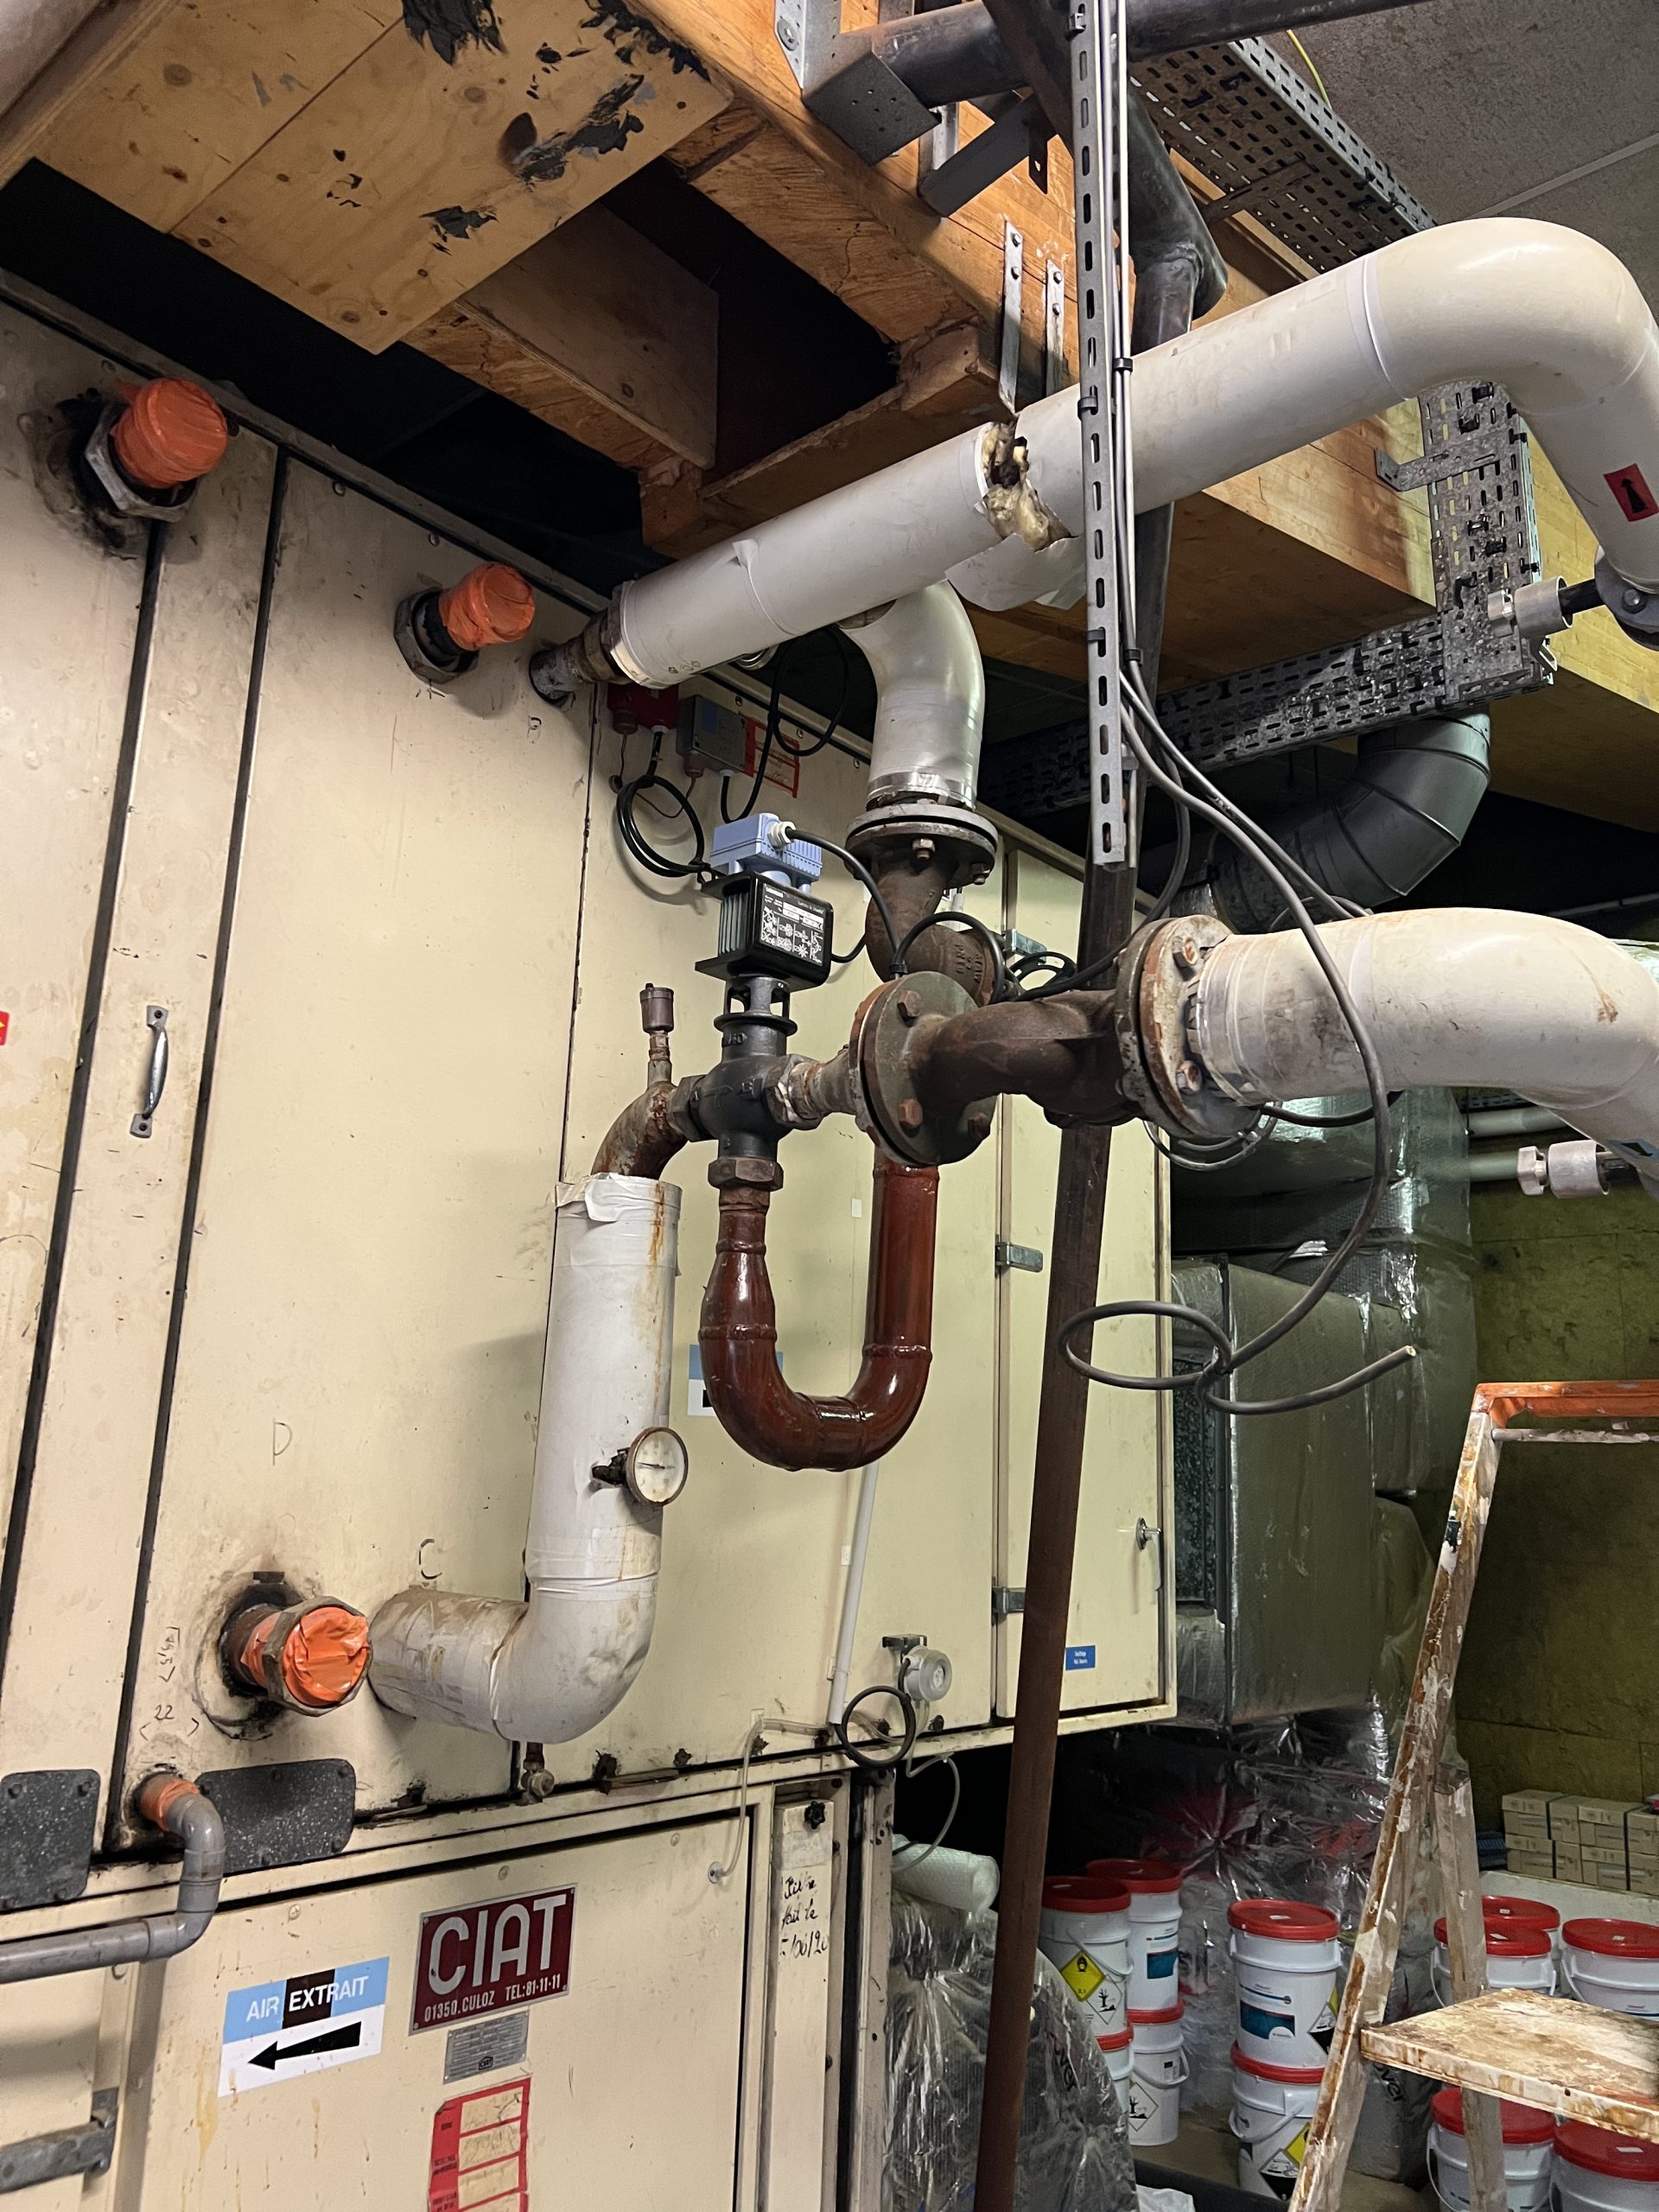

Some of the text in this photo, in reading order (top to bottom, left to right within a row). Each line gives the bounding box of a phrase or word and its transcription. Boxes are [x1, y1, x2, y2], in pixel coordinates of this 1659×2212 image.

[154, 1704, 175, 1721] 22
[429, 1893, 567, 1995] CIAT
[246, 1975, 369, 2023] AIR EXTRAIT
